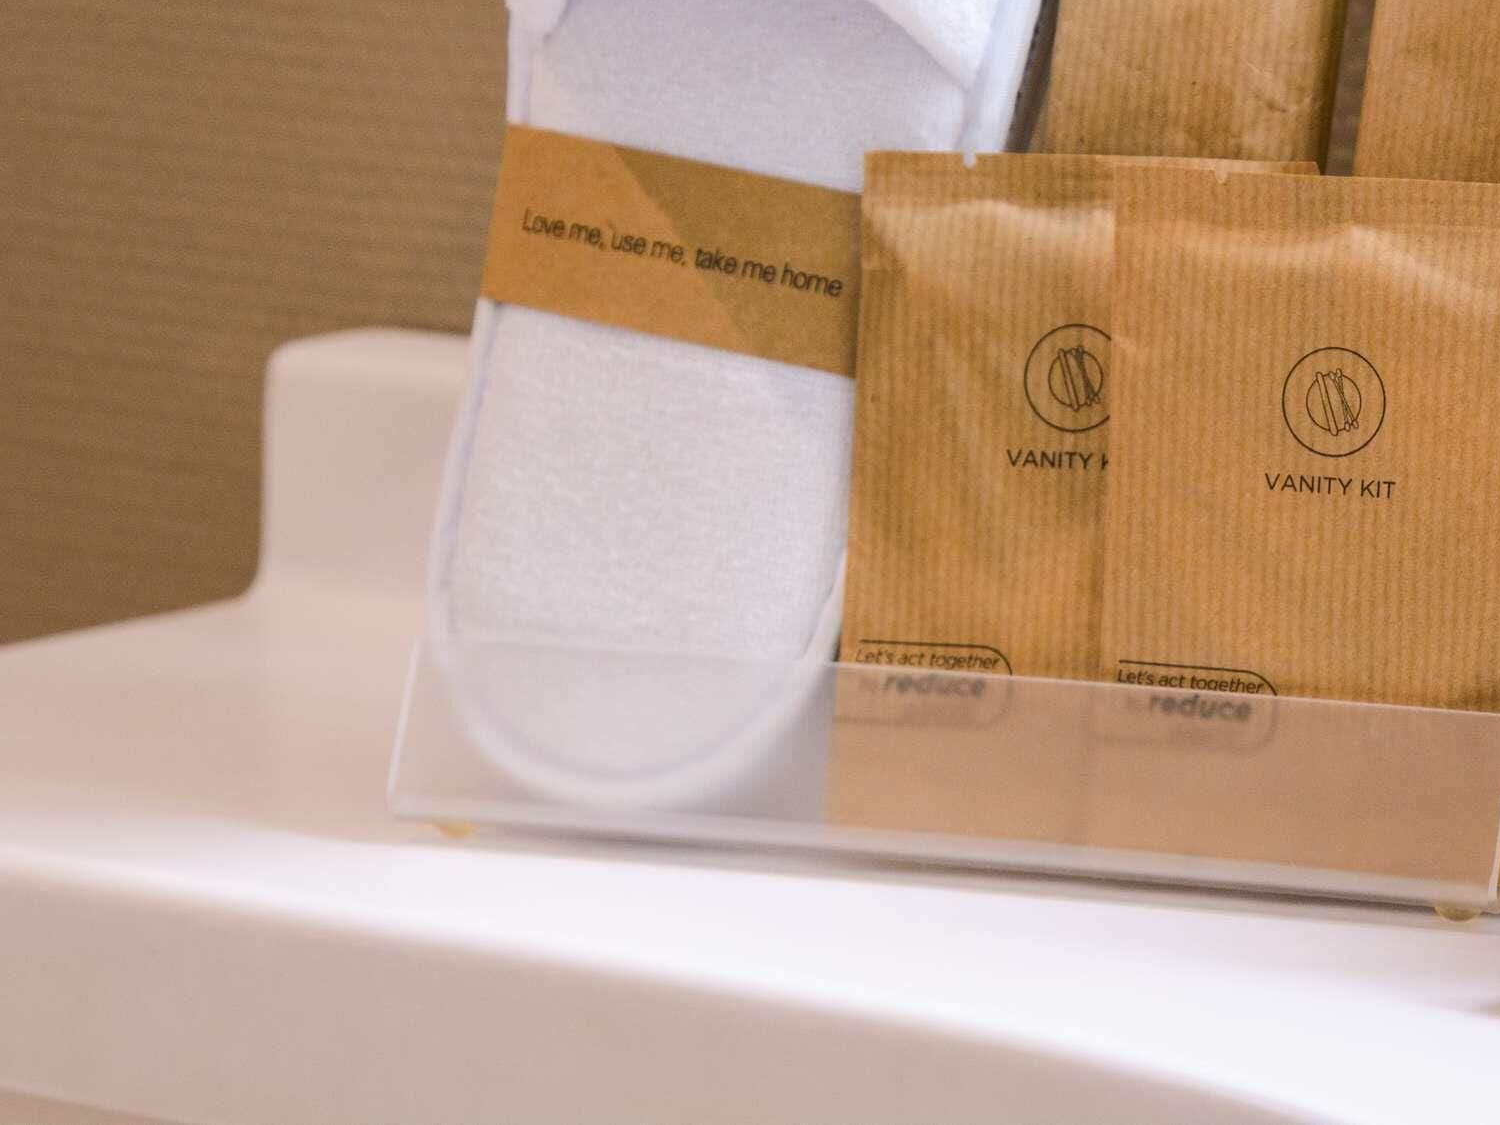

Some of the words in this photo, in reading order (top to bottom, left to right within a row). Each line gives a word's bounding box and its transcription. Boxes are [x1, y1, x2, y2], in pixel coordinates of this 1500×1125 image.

[522, 208, 566, 238] Love
[569, 222, 605, 250] me,
[611, 229, 646, 255] use
[650, 239, 686, 267] me,
[695, 246, 738, 276] take
[742, 258, 777, 284] me
[781, 262, 843, 298] home
[1007, 449, 1093, 470] VANITY
[1265, 472, 1354, 496] VANITY
[1361, 478, 1396, 499] KIT
[856, 648, 894, 665] Let's
[897, 651, 926, 666] act
[930, 653, 1002, 671] together
[1117, 667, 1154, 687] Let's
[1158, 672, 1186, 689] act
[1192, 674, 1265, 694] together
[1148, 695, 1252, 723] reduce
